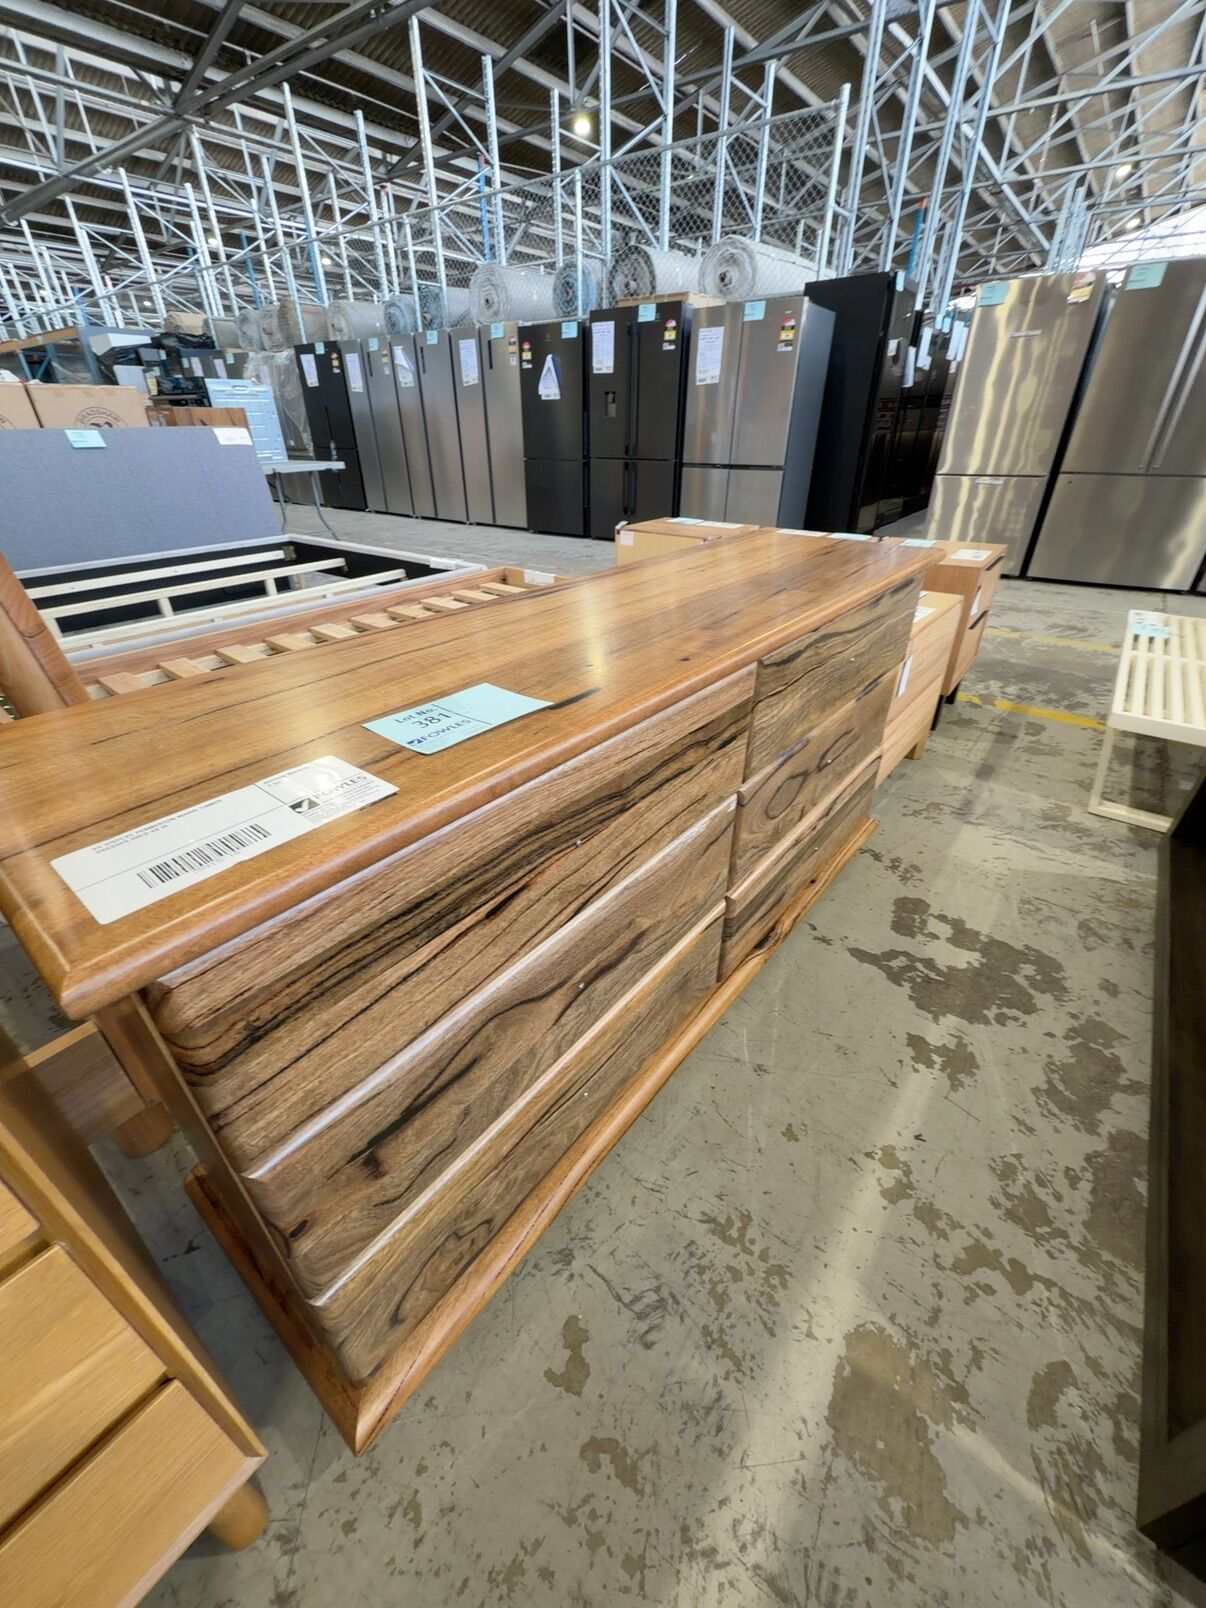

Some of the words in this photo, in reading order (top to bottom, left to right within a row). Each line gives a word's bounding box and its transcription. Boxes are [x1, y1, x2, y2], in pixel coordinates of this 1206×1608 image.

[394, 714, 415, 724] Lot
[411, 712, 452, 729] 381
[420, 719, 472, 742] FOWLES
